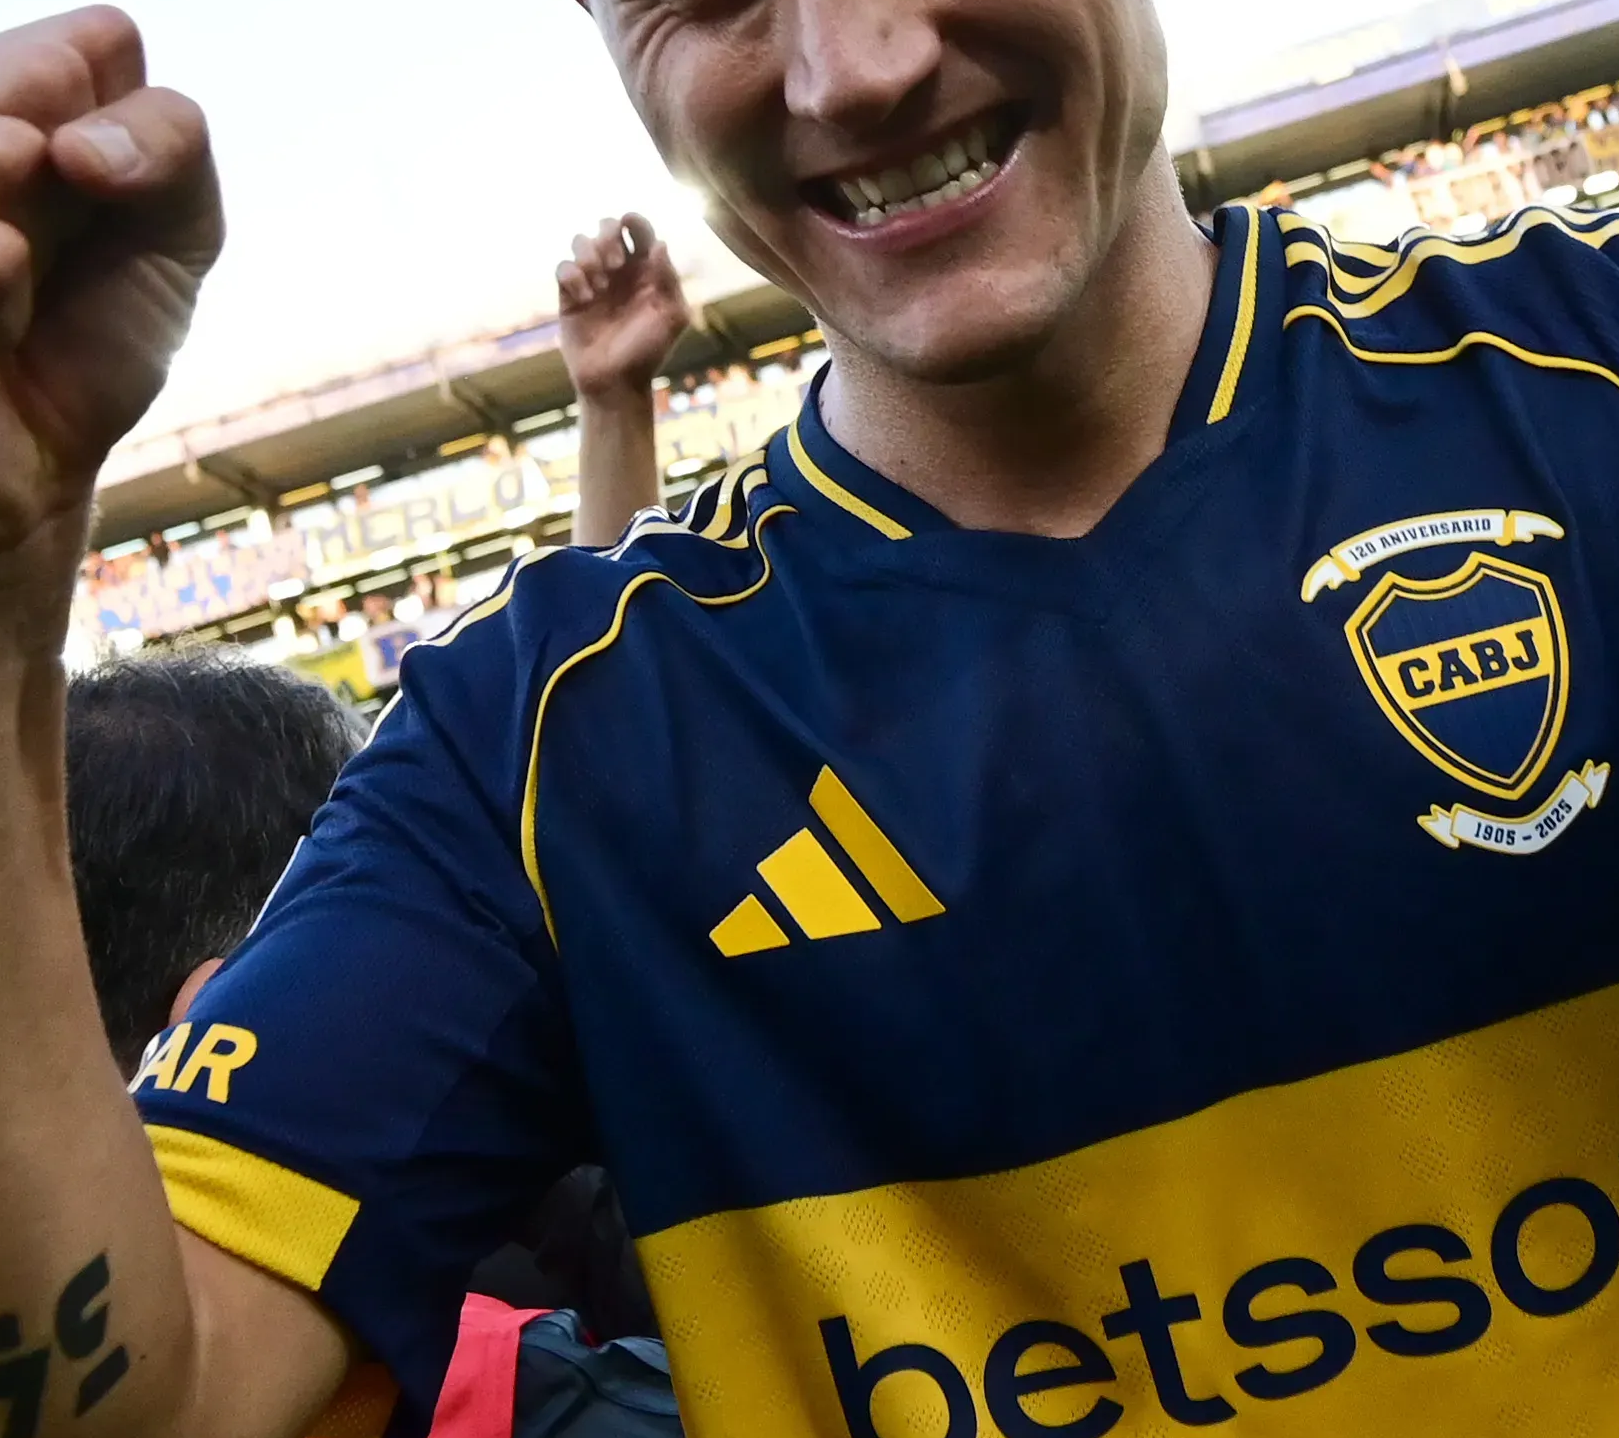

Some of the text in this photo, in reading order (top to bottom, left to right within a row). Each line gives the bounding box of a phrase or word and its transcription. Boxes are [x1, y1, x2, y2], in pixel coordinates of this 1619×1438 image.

[1348, 516, 1493, 563] 120 ANIVERSARIO
[1398, 629, 1541, 700] CABJ
[1473, 820, 1517, 848] 1905
[1535, 798, 1574, 840] 2025
[125, 1021, 258, 1105] AR
